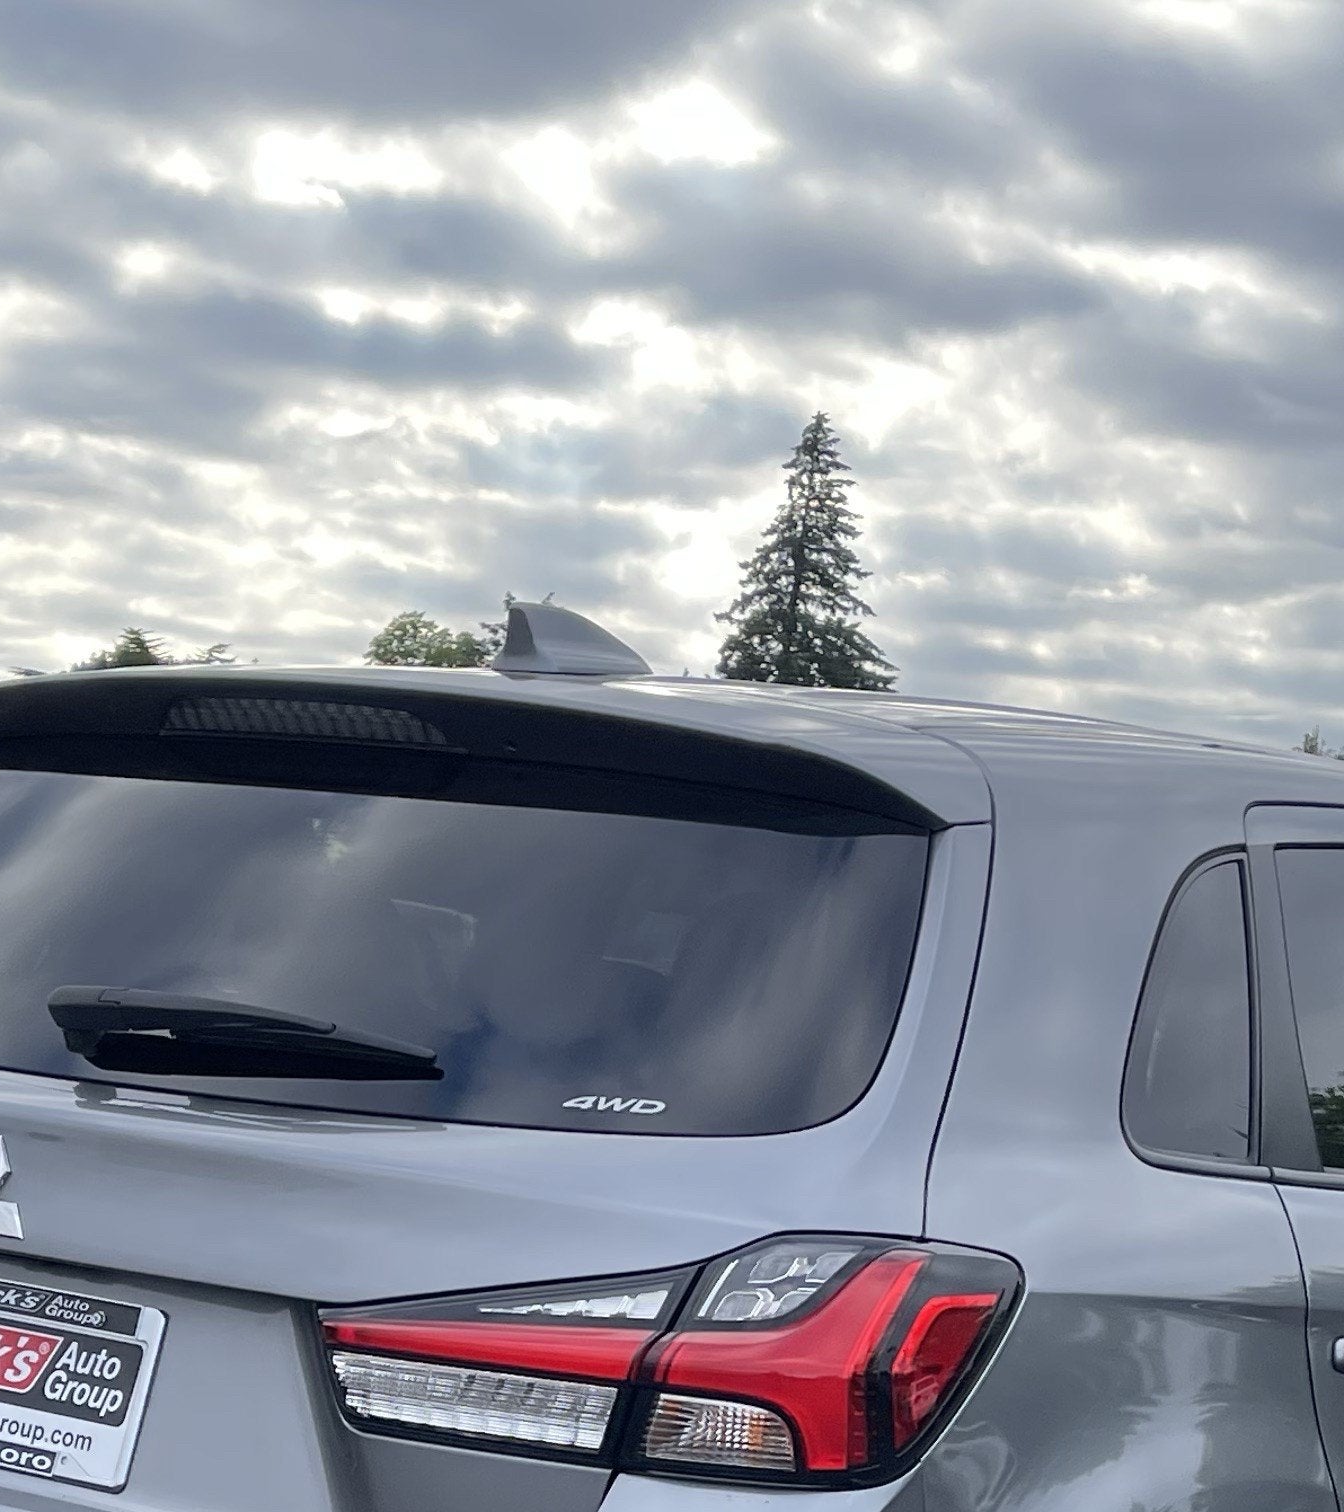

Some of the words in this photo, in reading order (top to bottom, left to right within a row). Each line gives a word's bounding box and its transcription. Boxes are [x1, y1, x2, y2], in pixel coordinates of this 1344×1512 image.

[562, 1095, 666, 1114] 4WD
[50, 1294, 90, 1312] Auto
[44, 1305, 96, 1325] Group
[55, 1341, 122, 1380] Auto
[44, 1370, 124, 1418] Group
